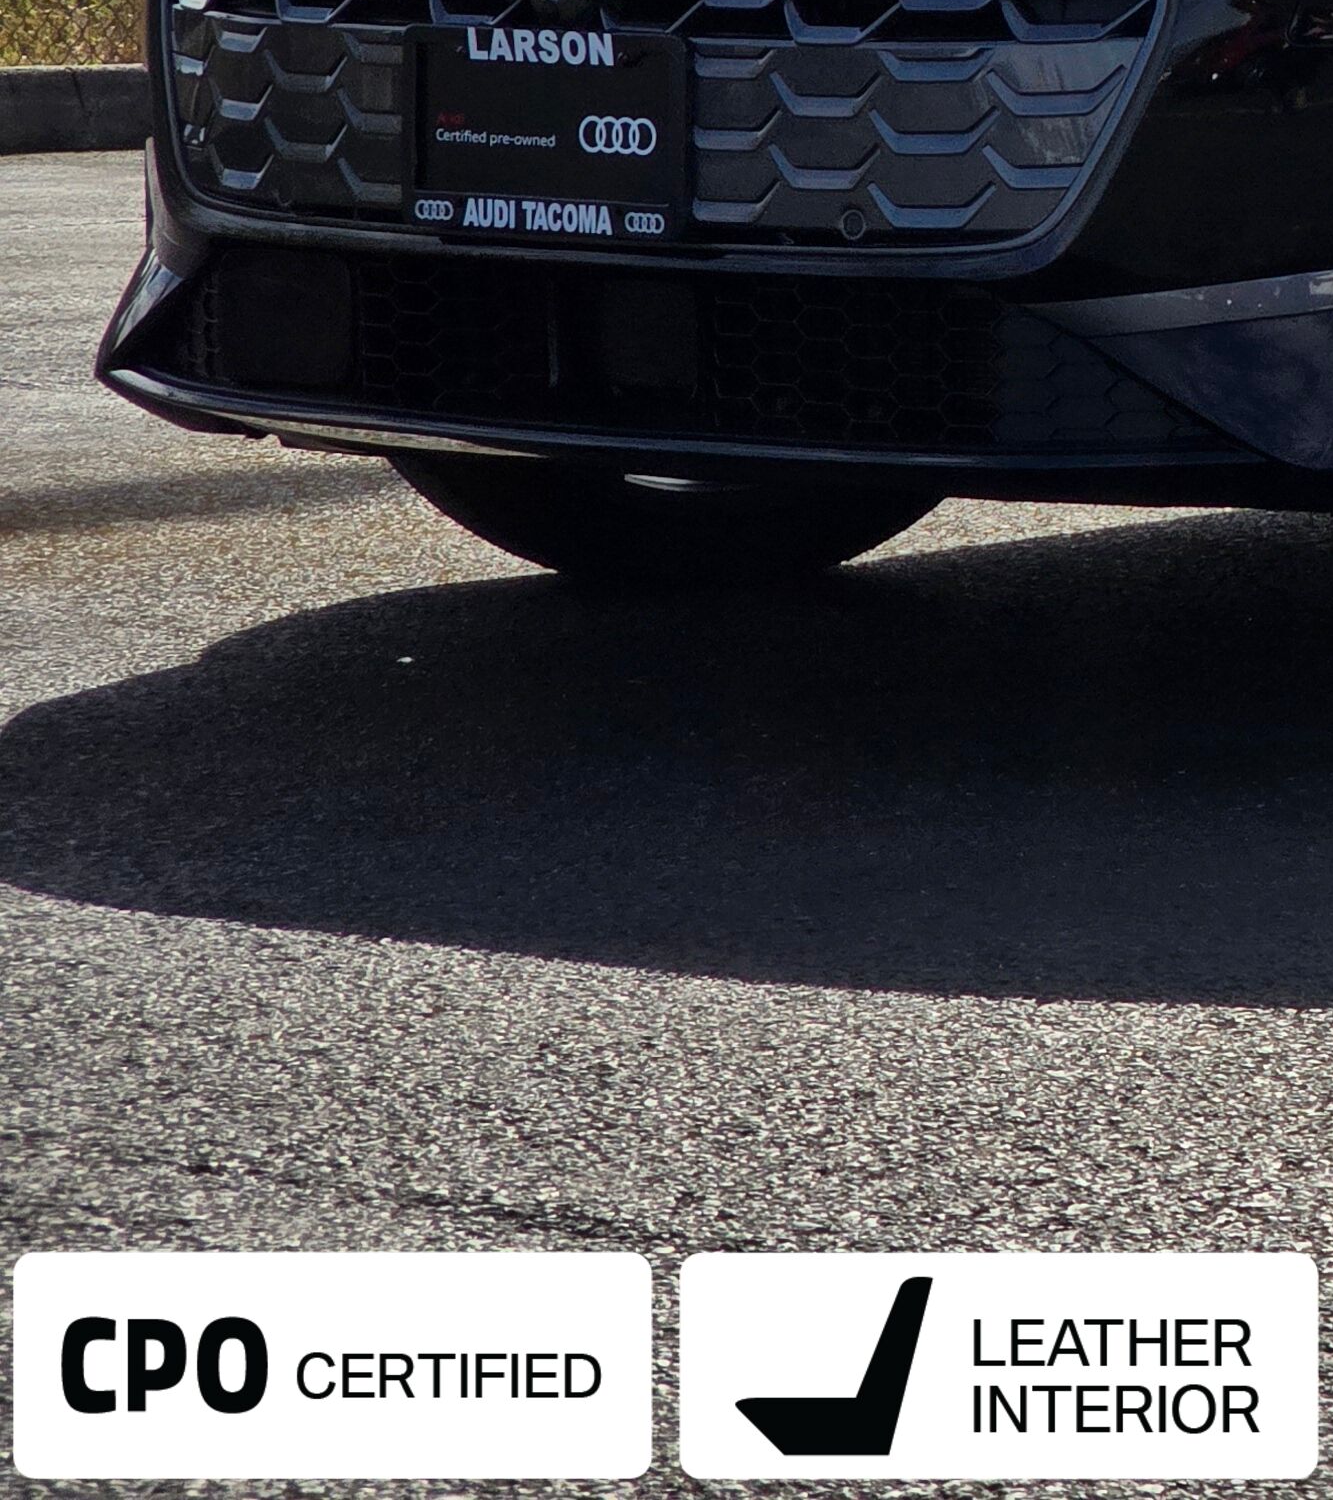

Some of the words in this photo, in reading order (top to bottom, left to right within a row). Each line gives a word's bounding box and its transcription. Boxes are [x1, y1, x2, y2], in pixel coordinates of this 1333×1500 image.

[467, 26, 614, 66] LARSON
[435, 128, 487, 144] Certified
[489, 134, 557, 148] pre-owned
[463, 198, 516, 229] AUDI
[522, 201, 613, 236] TACOMA
